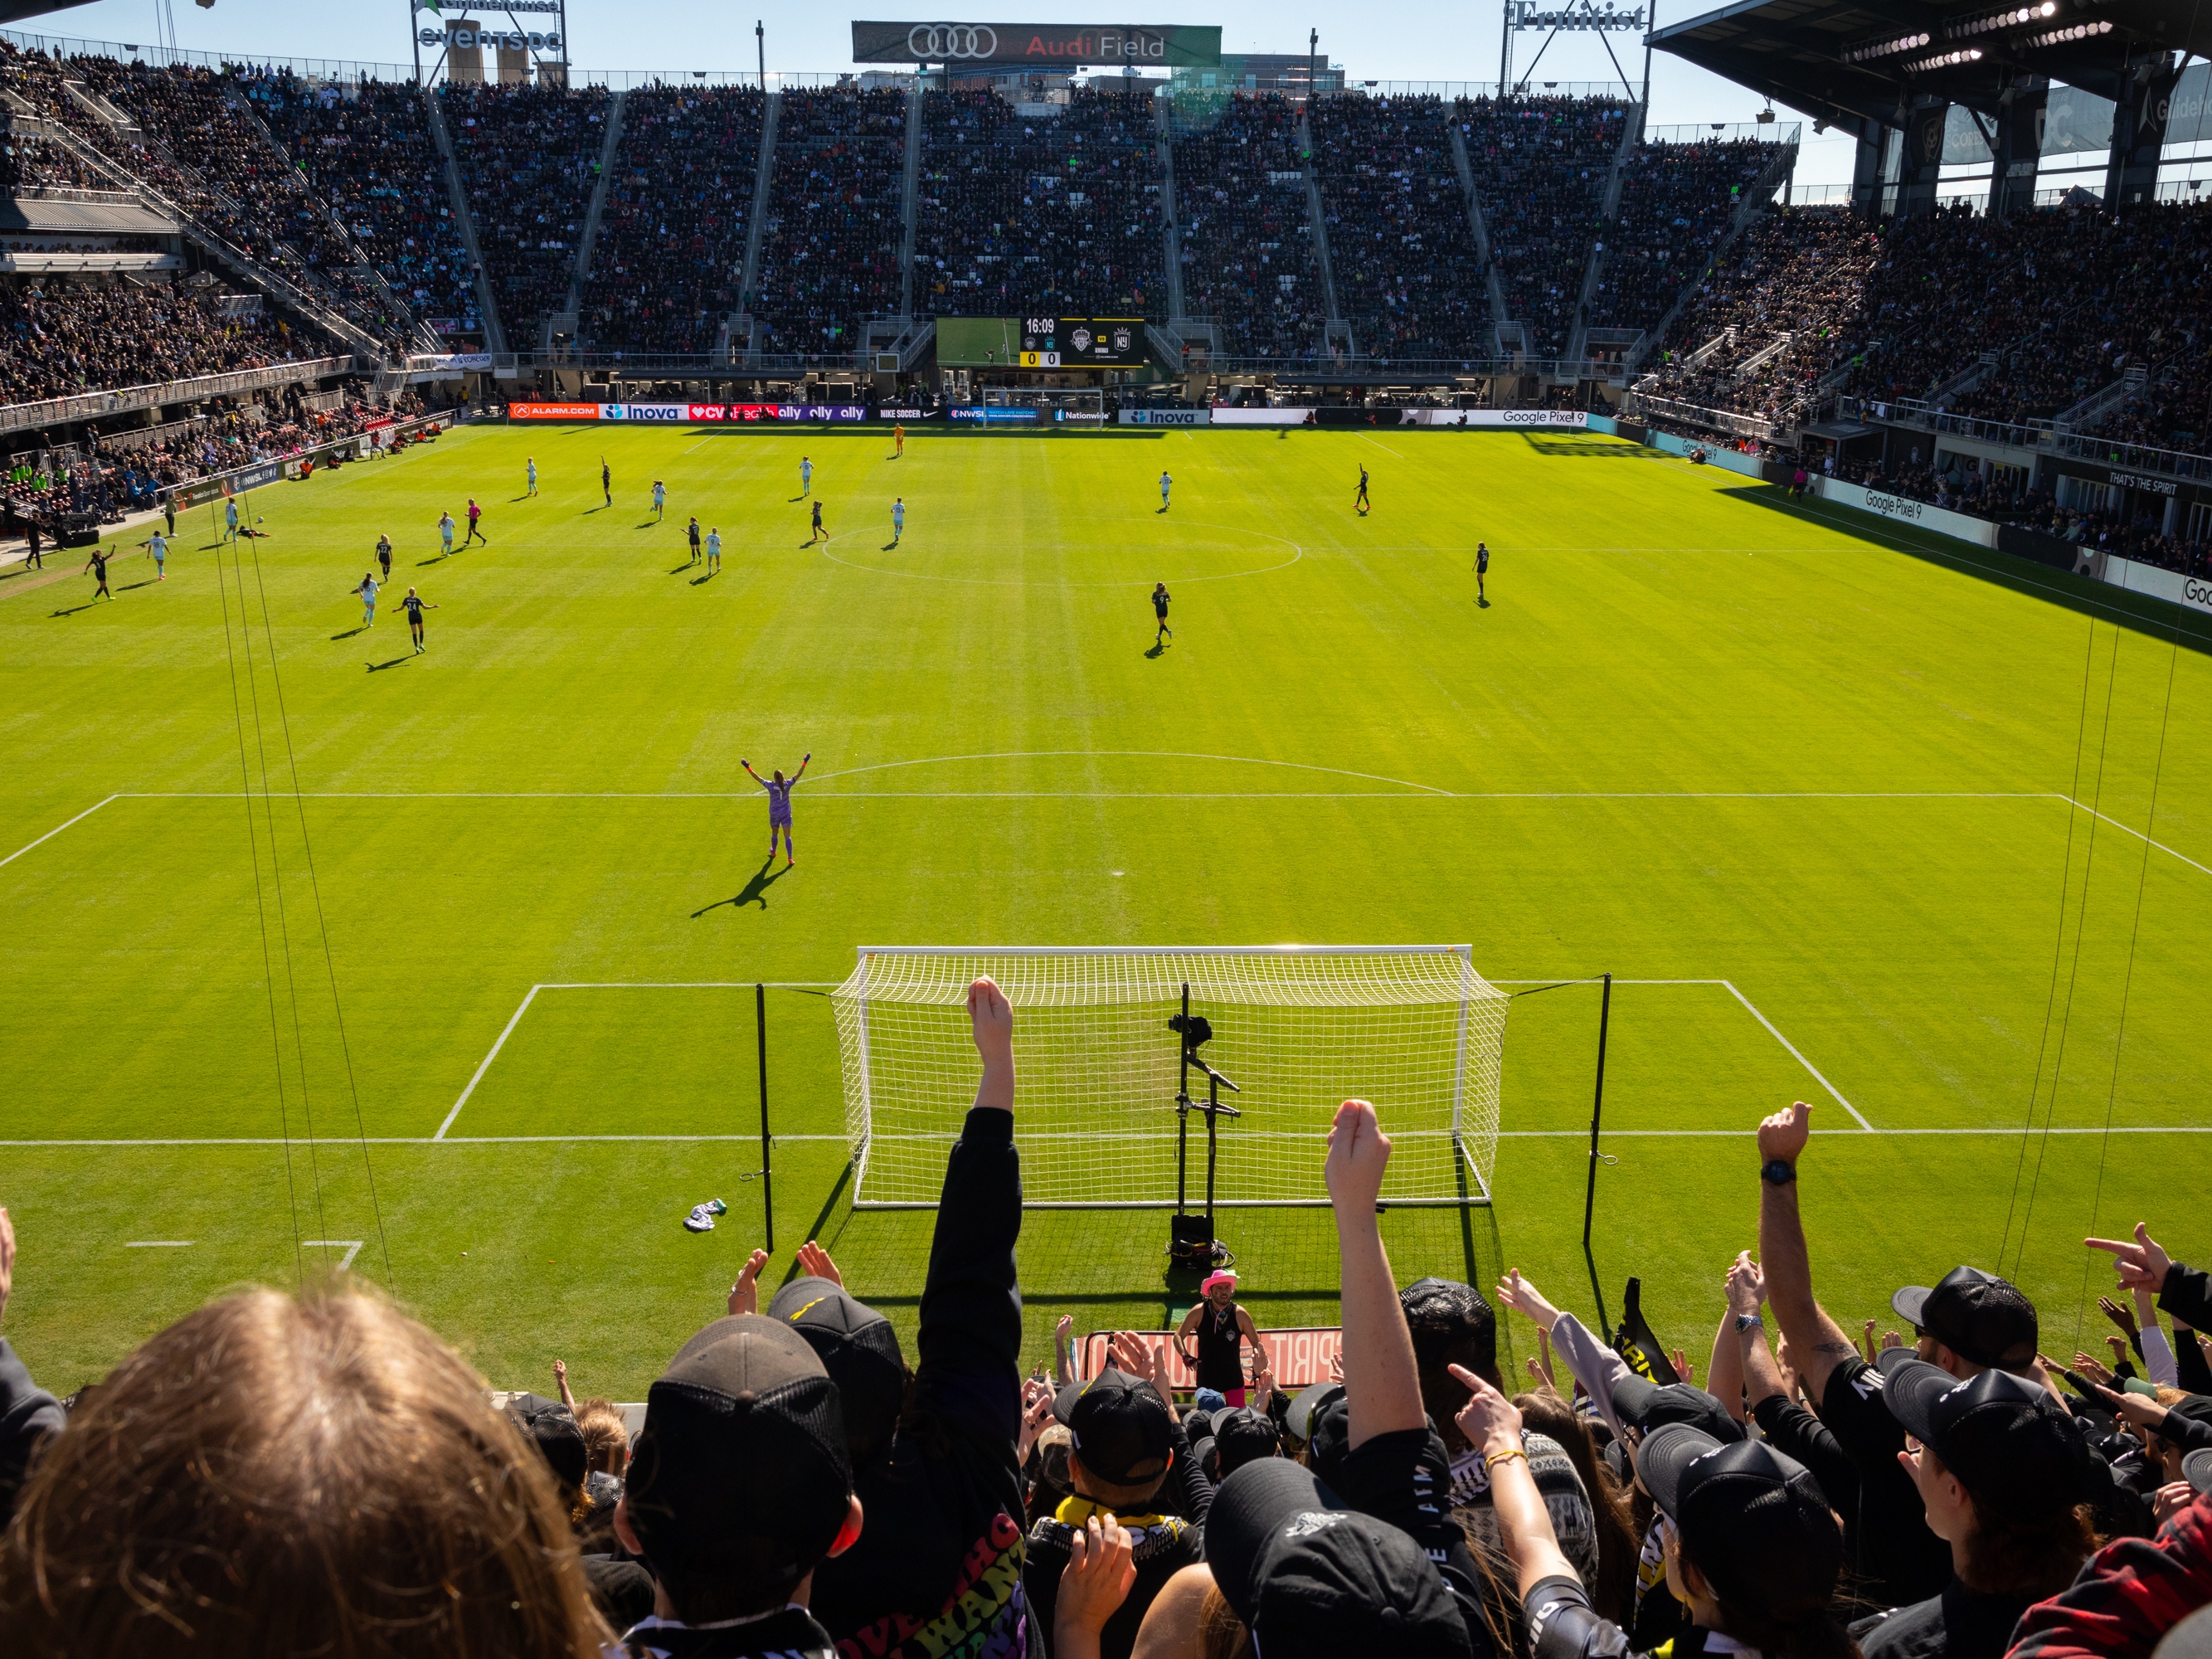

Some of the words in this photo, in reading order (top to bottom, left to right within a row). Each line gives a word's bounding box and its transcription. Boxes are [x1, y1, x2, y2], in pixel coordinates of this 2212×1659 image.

[1503, 1, 1646, 32] Fruitist
[527, 32, 562, 52] DC
[1026, 36, 1091, 56] Audi
[1100, 36, 1164, 57] Field
[2035, 105, 2073, 151] DC
[1026, 318, 1054, 333] 16:09
[1028, 353, 1036, 365] 0
[1048, 353, 1056, 365] 0
[627, 404, 679, 420] Inova
[705, 406, 733, 419] CV
[778, 406, 802, 421] ally
[809, 406, 833, 421] ally
[840, 406, 864, 421] ally
[880, 410, 896, 418] NIKE
[897, 410, 921, 418] SOCCER
[1150, 411, 1195, 424] Inova
[1503, 411, 1547, 425] Google
[1549, 411, 1574, 423] Pixel
[1577, 412, 1584, 423] 9
[2110, 471, 2135, 488] THAT'S
[2136, 476, 2152, 490] THE
[2153, 480, 2178, 496] SPIRIT
[1865, 489, 1894, 515] Google
[1895, 498, 1916, 518] Pixel
[1916, 504, 1923, 519] 9
[1159, 596, 1164, 604] 9
